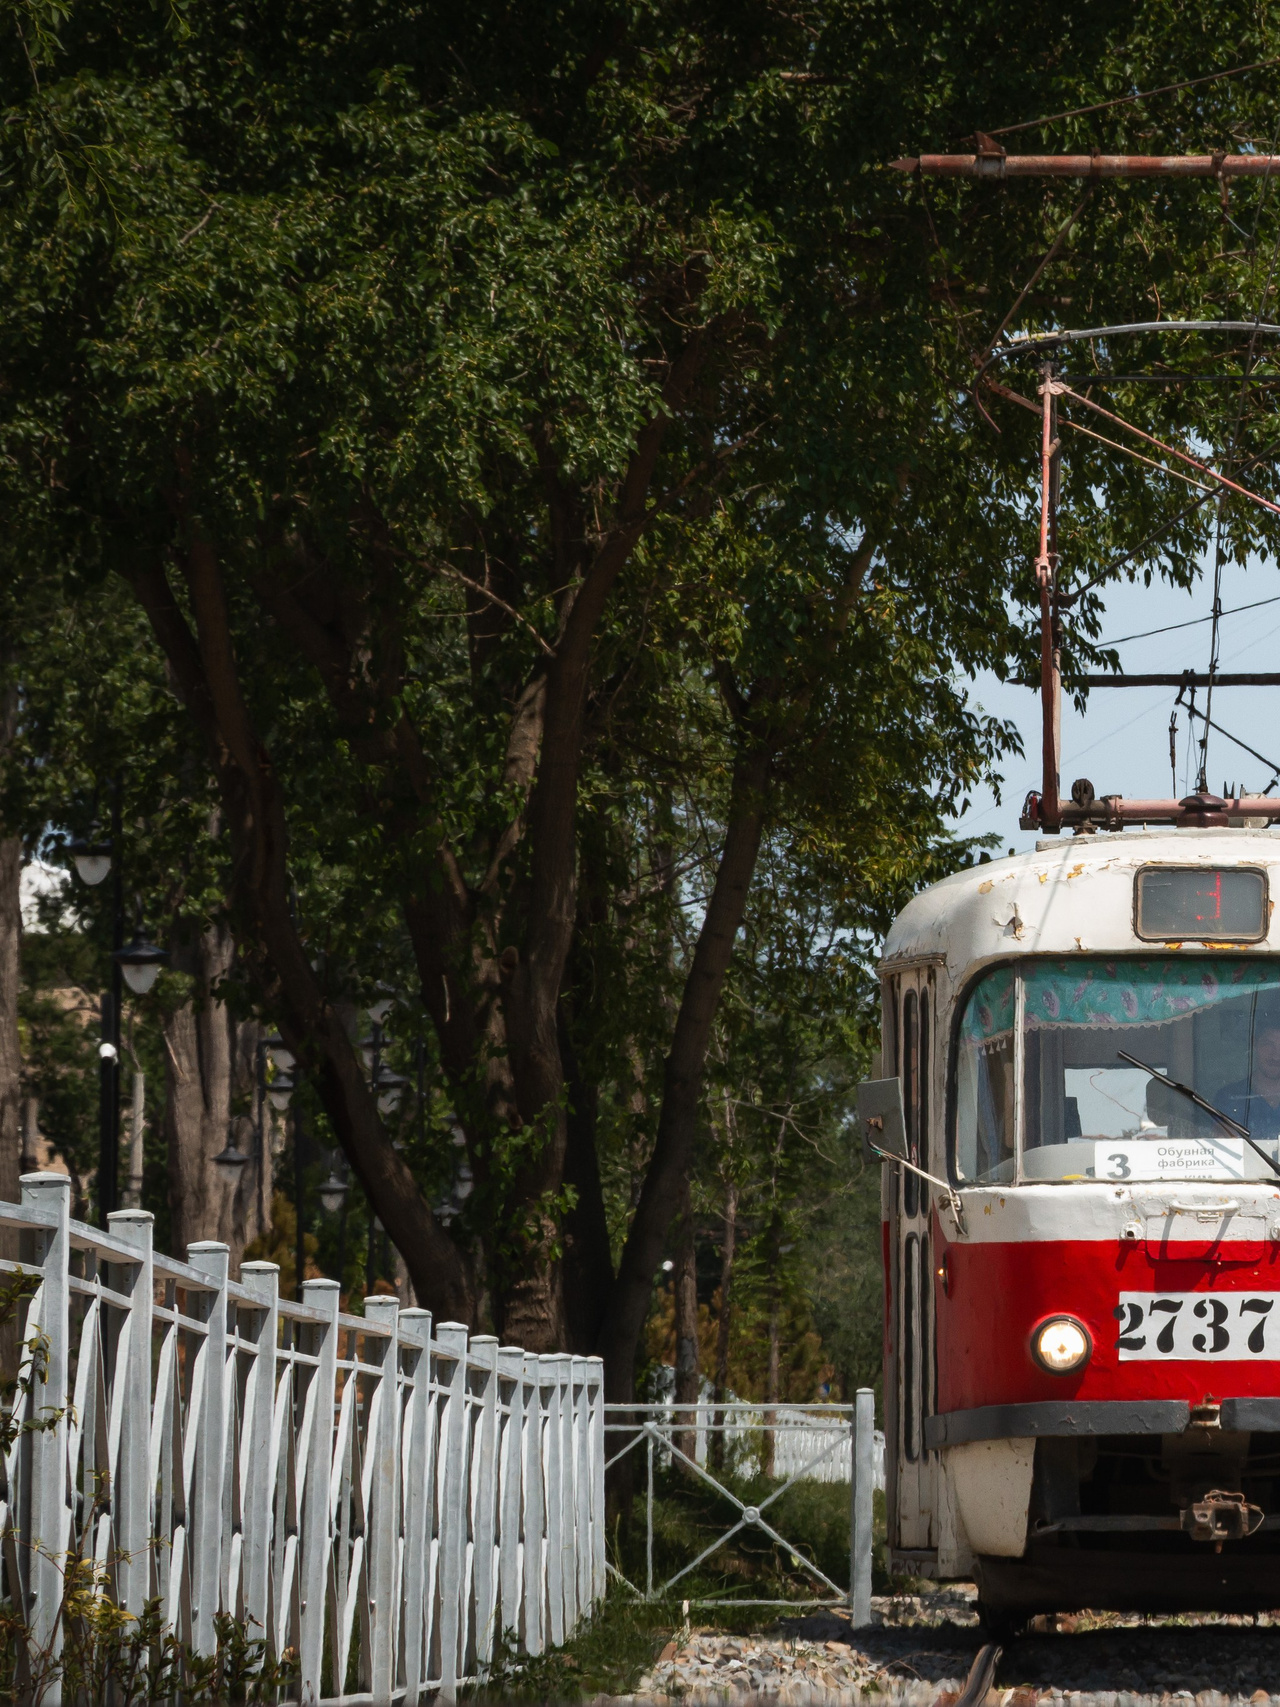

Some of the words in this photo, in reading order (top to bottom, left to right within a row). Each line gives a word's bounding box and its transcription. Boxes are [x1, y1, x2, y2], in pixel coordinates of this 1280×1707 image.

[1157, 1147, 1215, 1158] Обувная
[1107, 1153, 1132, 1179] 3
[1157, 1157, 1215, 1168] фабрика
[1113, 1299, 1274, 1354] 2737
